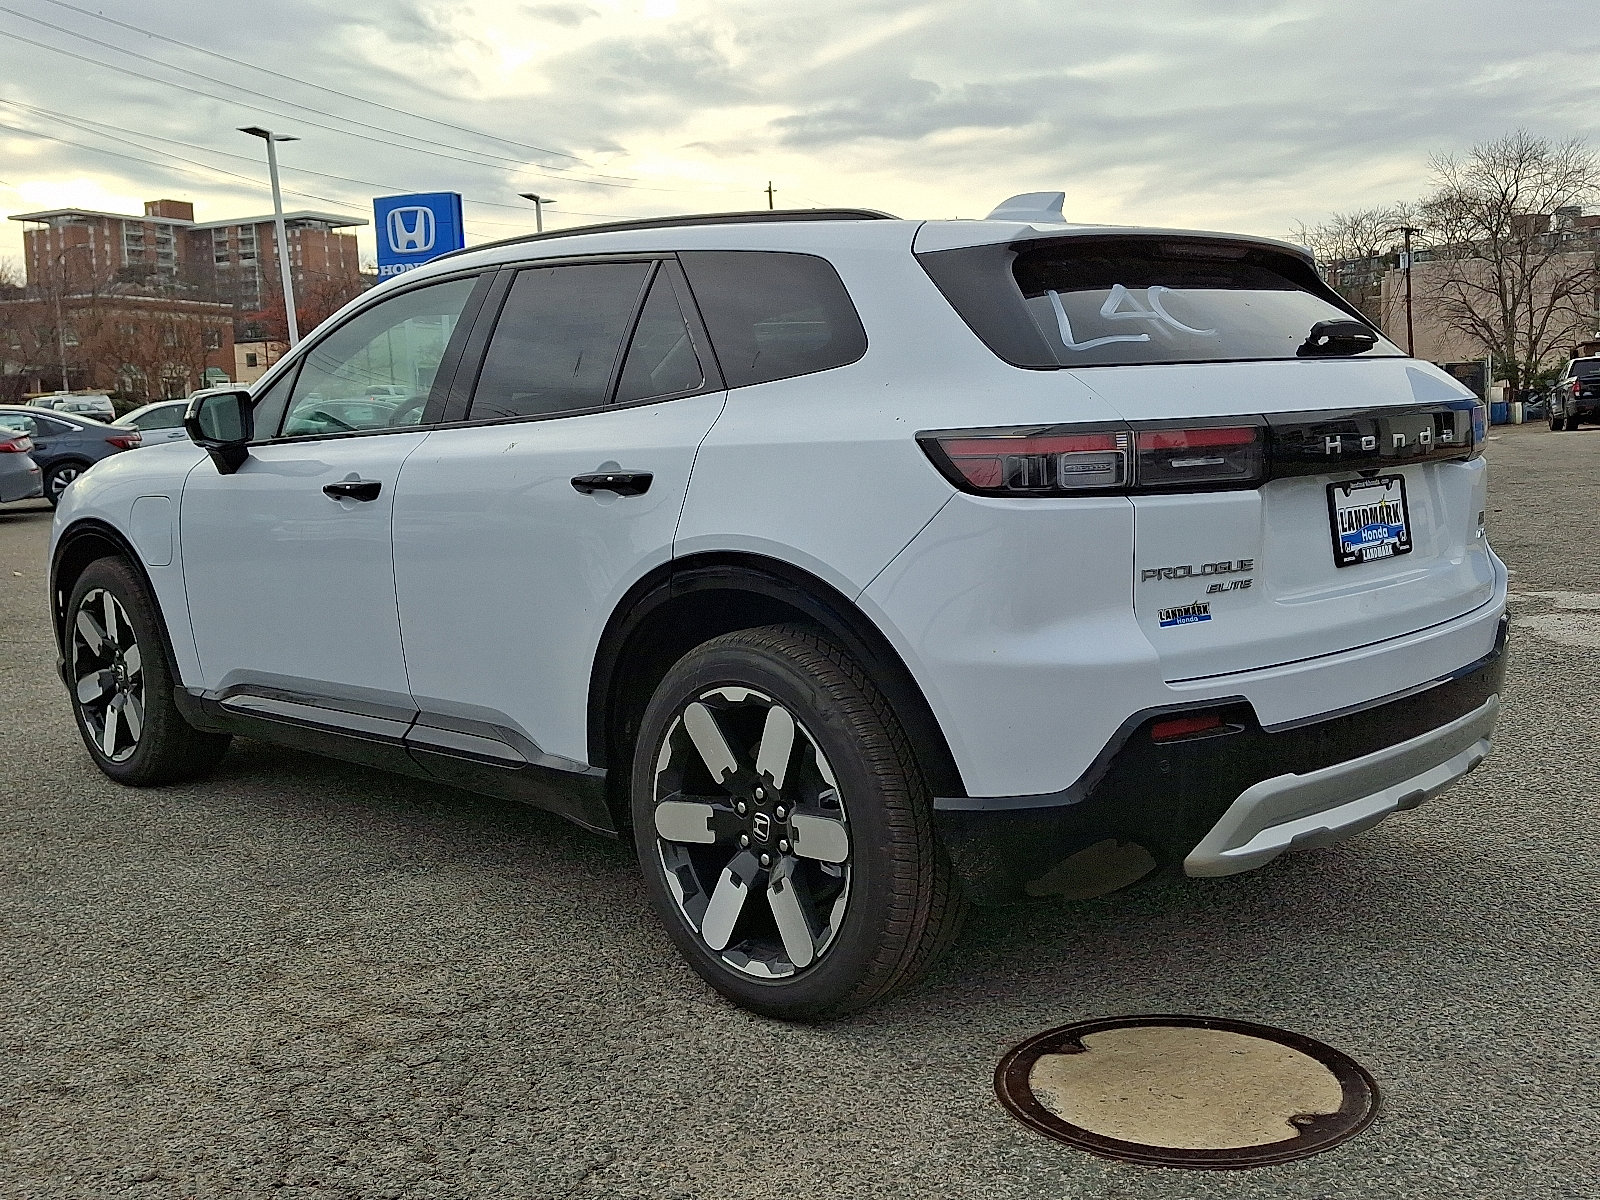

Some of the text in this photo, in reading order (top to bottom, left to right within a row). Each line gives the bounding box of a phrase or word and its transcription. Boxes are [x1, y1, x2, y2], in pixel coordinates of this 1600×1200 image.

[379, 263, 422, 276] HON
[1325, 427, 1454, 455] Honda
[1340, 503, 1401, 531] LANDMARK
[1361, 526, 1389, 542] Honda
[1142, 559, 1254, 582] PROLOGUE
[1206, 578, 1253, 593] ELITE
[1159, 604, 1209, 621] LANDMARK
[1176, 616, 1199, 625] Honda
